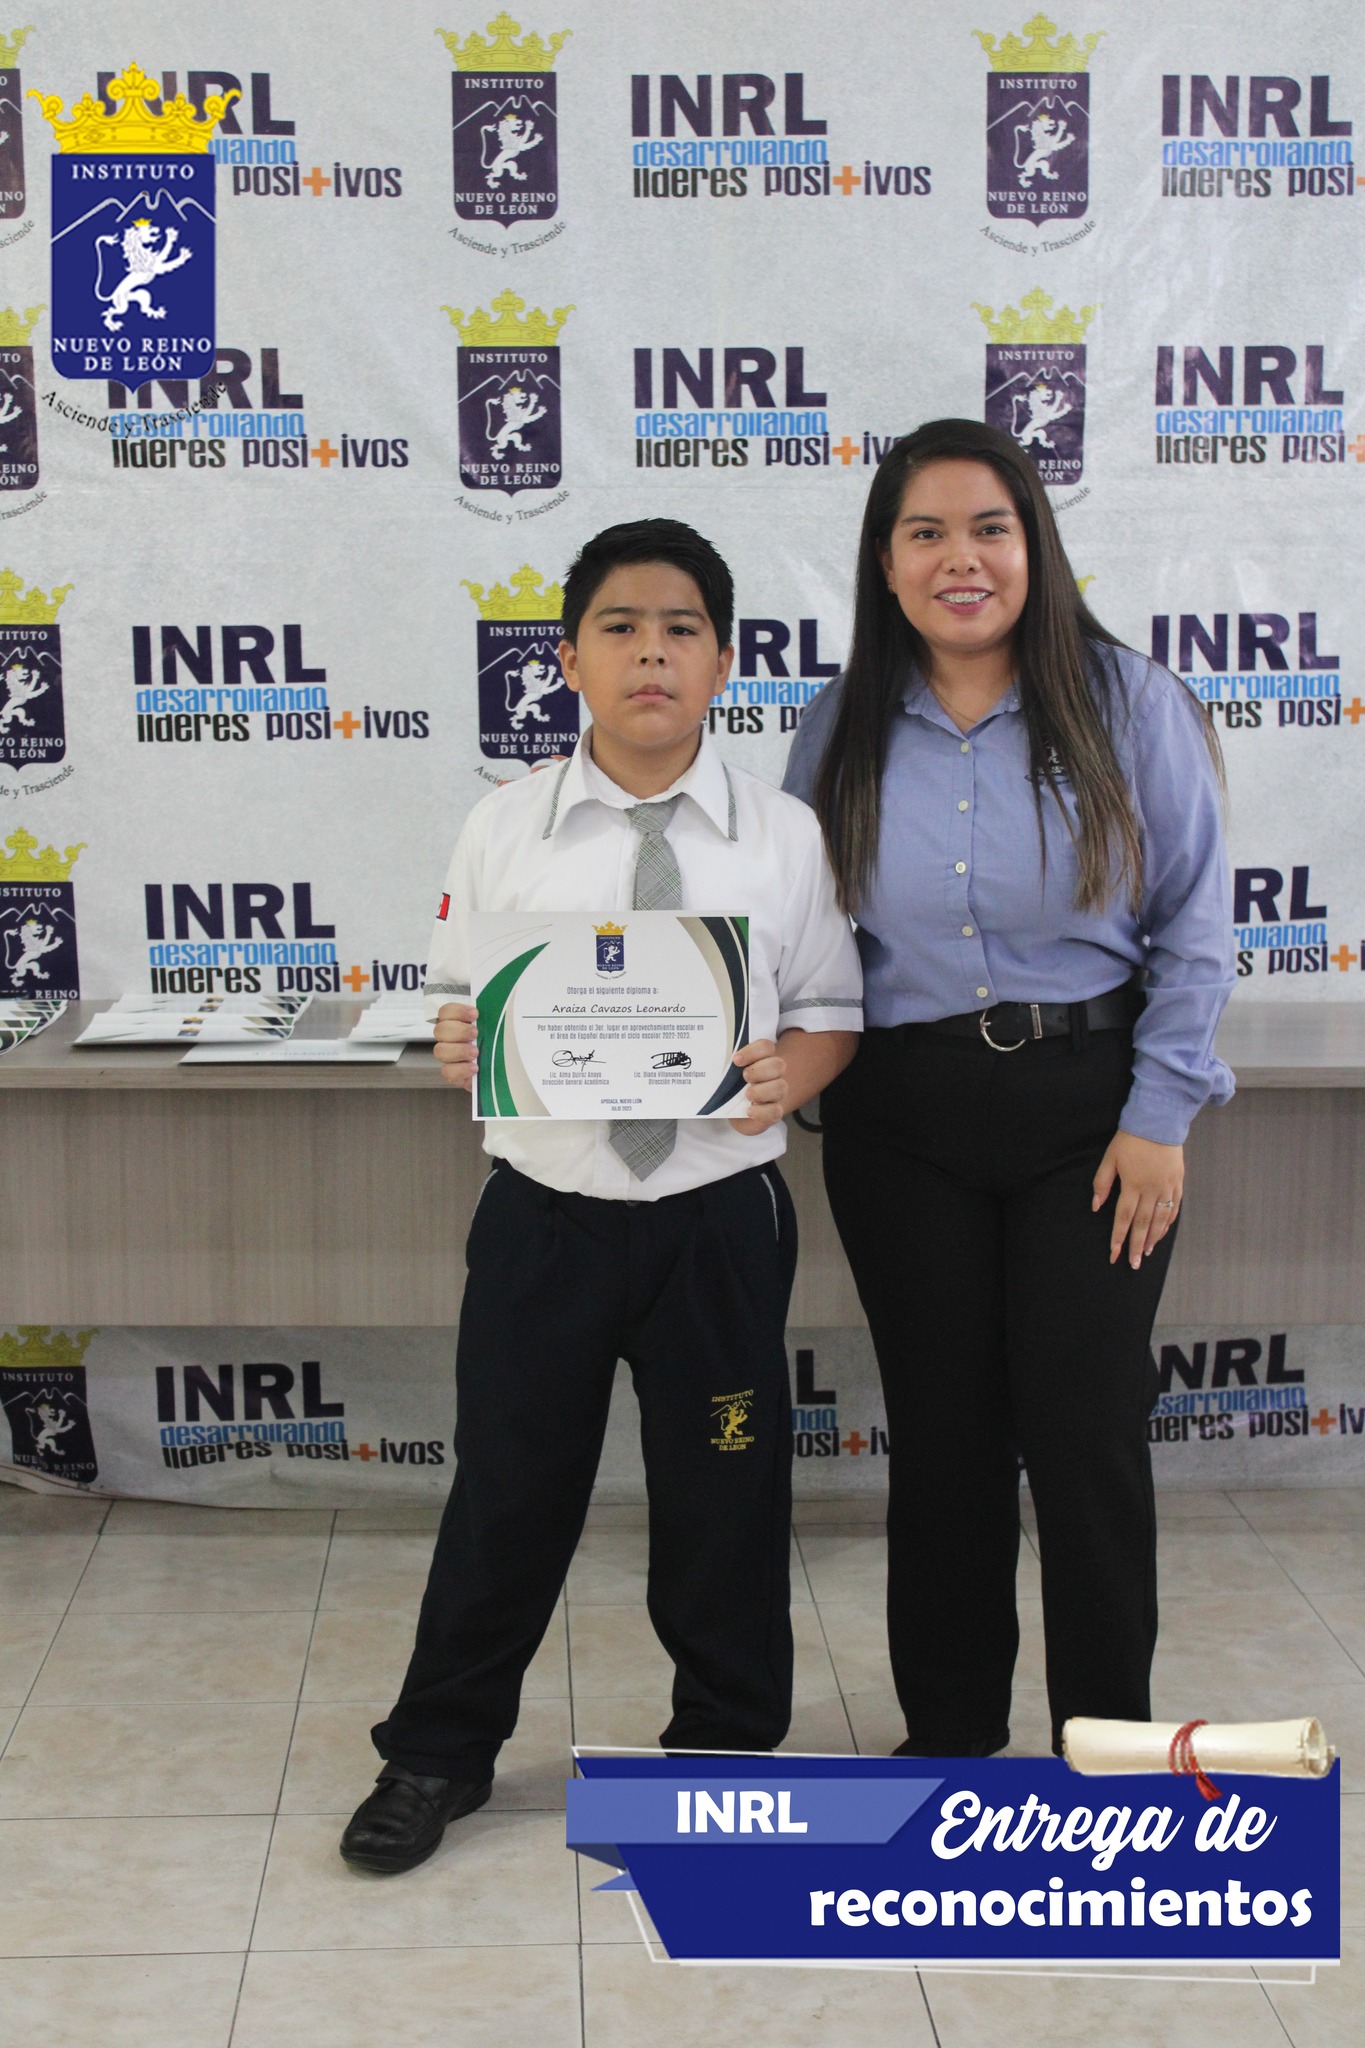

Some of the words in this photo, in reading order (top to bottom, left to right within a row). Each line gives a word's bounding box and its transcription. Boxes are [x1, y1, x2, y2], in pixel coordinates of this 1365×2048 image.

[465, 79, 544, 89] INSTITUTO
[1000, 79, 1077, 89] INSTITUTO
[631, 72, 827, 137] INRL
[1161, 74, 1353, 138] INRL
[632, 139, 827, 167] desarrollando
[1162, 140, 1352, 167] desarrollando
[455, 193, 506, 202] NUEVO
[511, 193, 556, 202] REINO
[988, 191, 1037, 202] NUEVO
[1042, 191, 1087, 202] REINO
[475, 205, 494, 214] DE
[499, 203, 538, 214] LEÓN
[1007, 204, 1026, 214] DE
[1031, 202, 1069, 214] LEÓN
[449, 226, 498, 256] Asciende
[501, 248, 508, 258] y
[511, 220, 567, 254] Trasciende
[979, 225, 1028, 254] Asciende
[1031, 246, 1038, 257] y
[1041, 219, 1097, 253] Trasciende
[470, 353, 548, 364] INSTITUTO
[998, 351, 1075, 361] INSTITUTO
[634, 346, 828, 409] INRL
[1155, 345, 1344, 406] INRL
[635, 411, 827, 438] desarrollando
[1156, 409, 1343, 434] desarrollando
[460, 463, 510, 474] NUEVO
[516, 463, 560, 473] REINO
[1038, 459, 1082, 470] REINO
[480, 475, 499, 485] DE
[504, 473, 542, 485] LEÓN
[454, 495, 503, 522] Asciende
[505, 514, 513, 525] y
[515, 489, 570, 521] Trasciende
[489, 626, 565, 637] INSTITUTO
[1152, 612, 1340, 673] INRL
[132, 624, 327, 685] INRL
[135, 686, 328, 713] desarrollando
[21, 737, 64, 748] REINO
[480, 733, 529, 743] NUEVO
[535, 733, 578, 743] REINO
[10, 747, 46, 758] LEÓN
[500, 745, 518, 754] DE
[523, 743, 560, 754] LEÓN
[12, 789, 20, 800] y
[22, 763, 75, 797] Trasciende
[145, 882, 336, 940] INRL
[149, 942, 336, 967] desarrollando
[35, 989, 78, 999] REINO
[566, 986, 587, 995] Otorga
[588, 986, 595, 994] el
[596, 986, 625, 995] siguiente
[626, 986, 651, 995] diploma
[552, 1003, 587, 1013] Araiza
[590, 1004, 632, 1013] Cavazos
[636, 1003, 686, 1013] Leonardo
[1159, 1333, 1305, 1393] NRL
[2, 1372, 74, 1382] INSTITUTO
[155, 1361, 345, 1422] INRL
[711, 1389, 754, 1402] INSTITUTO
[160, 1420, 345, 1447] desarrollando
